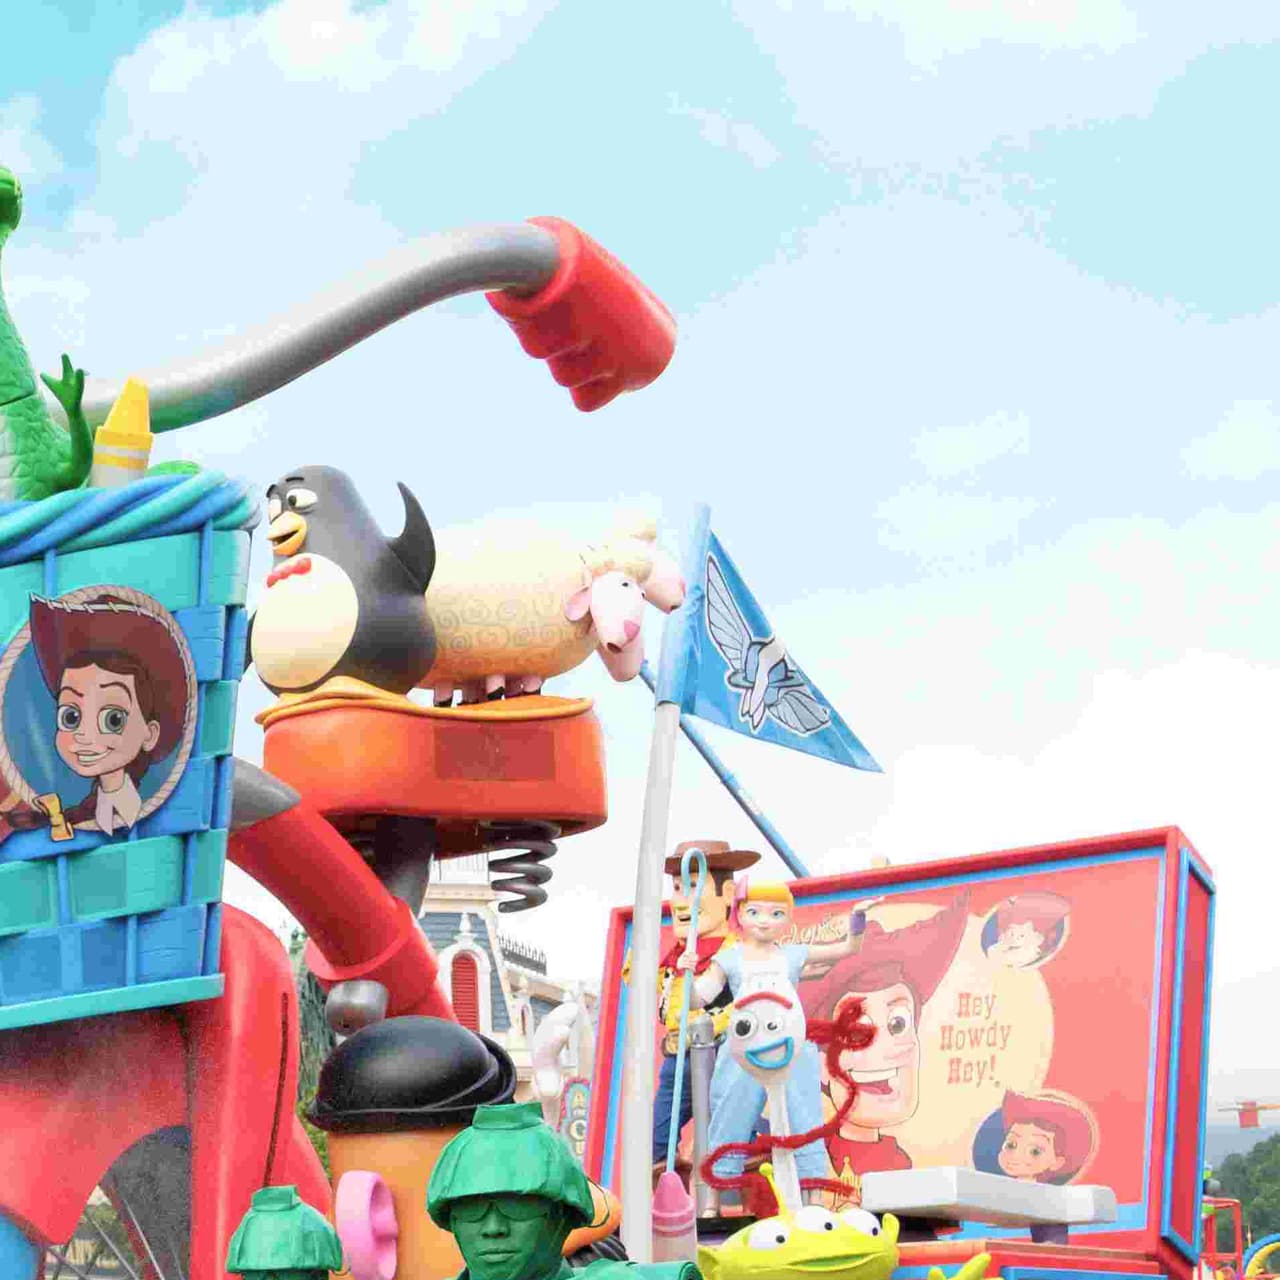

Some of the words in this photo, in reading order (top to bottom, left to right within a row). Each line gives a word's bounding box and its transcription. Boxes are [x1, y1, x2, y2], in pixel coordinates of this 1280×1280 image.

[957, 992, 997, 1020] Hey
[939, 1021, 1013, 1051] Howdy
[947, 1054, 997, 1088] Hey!
